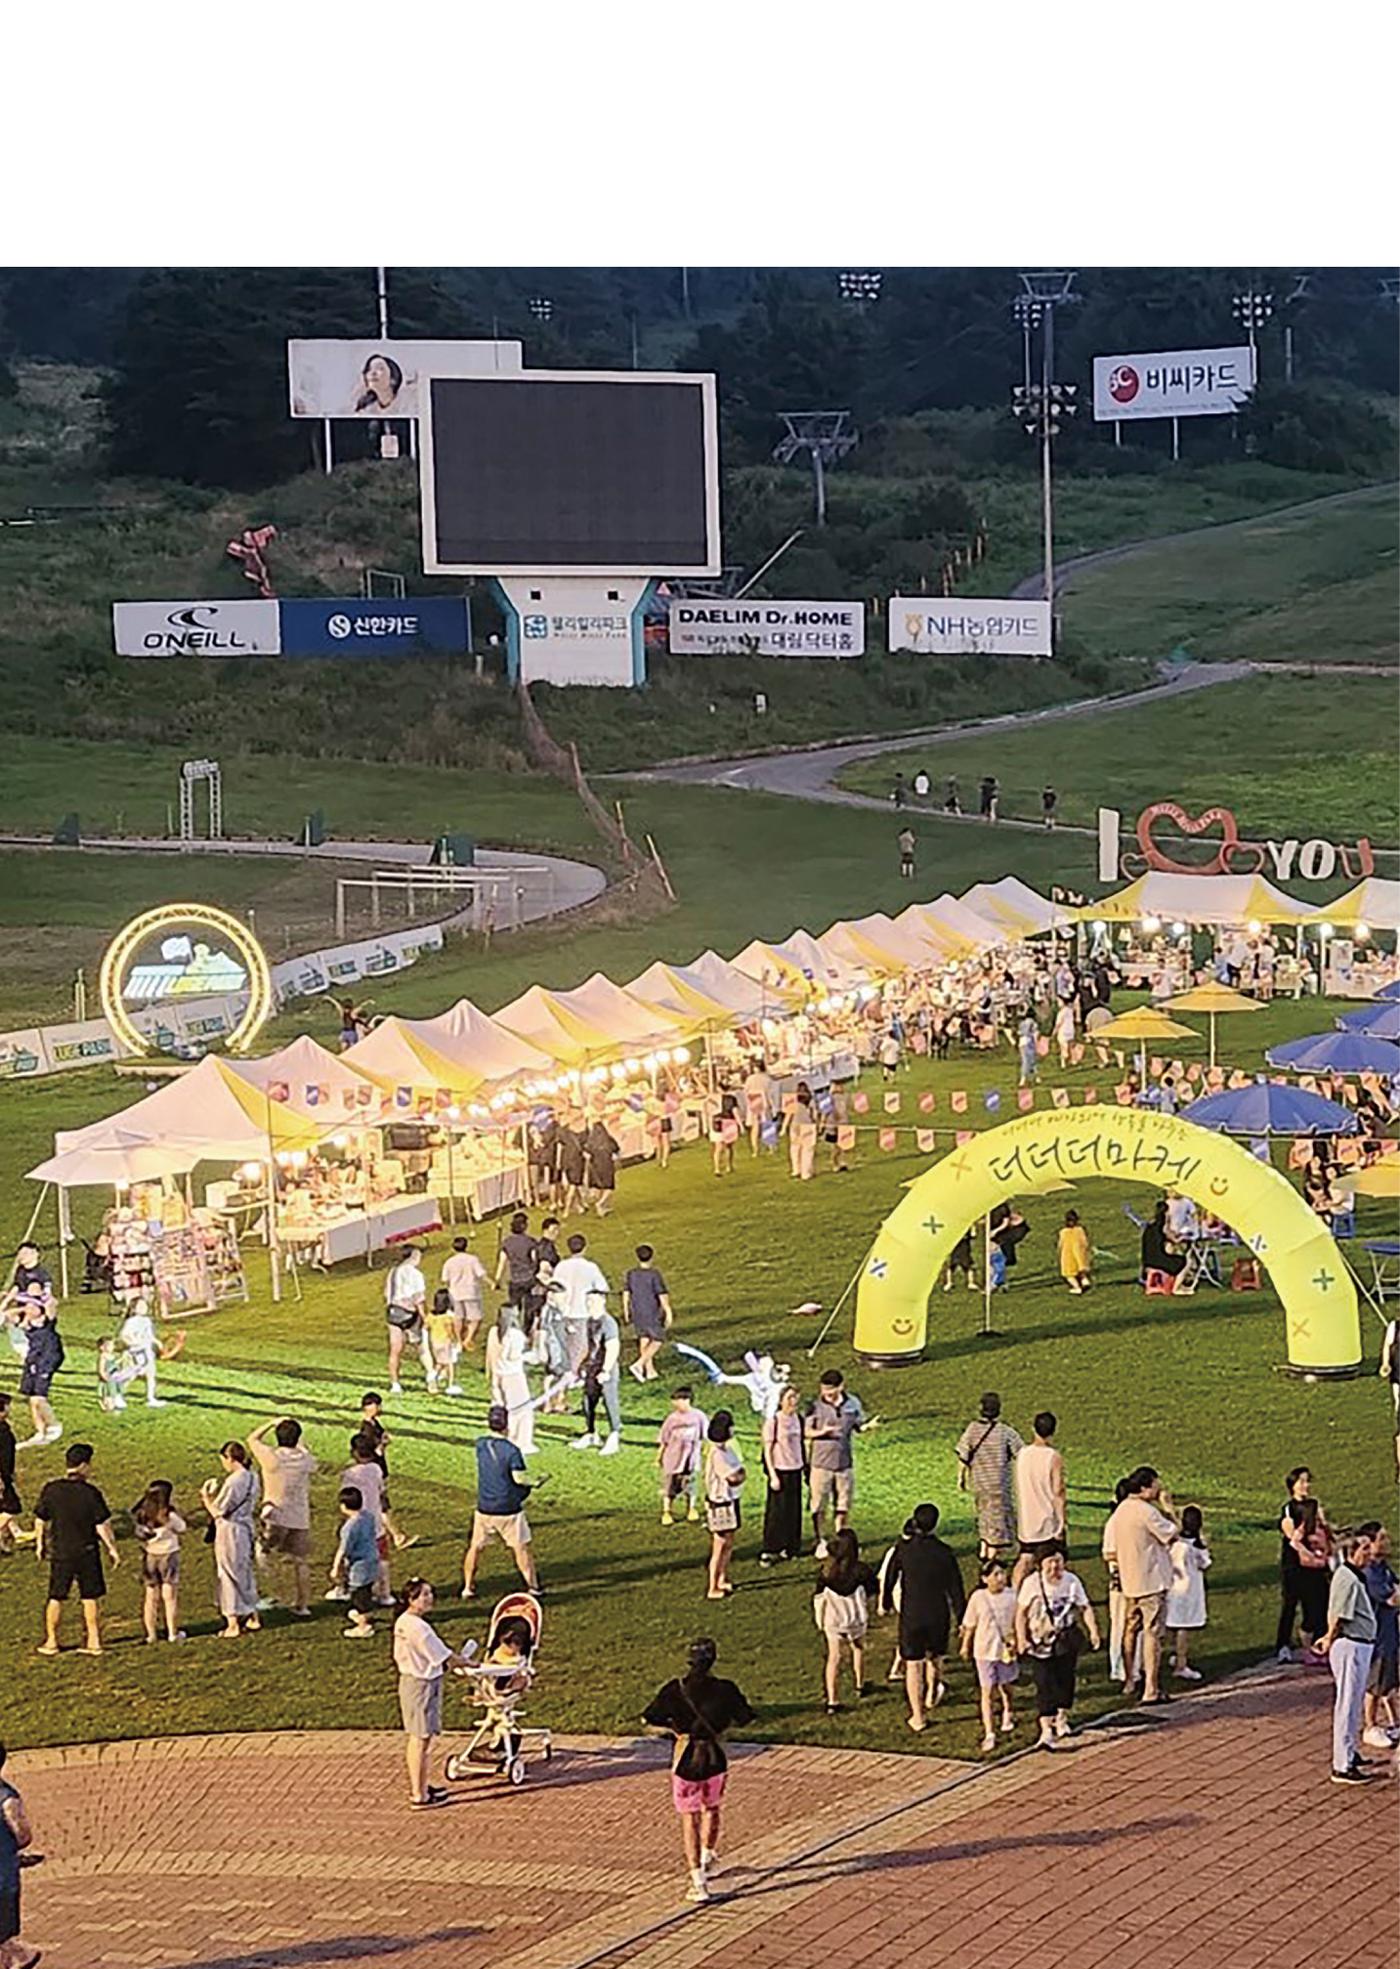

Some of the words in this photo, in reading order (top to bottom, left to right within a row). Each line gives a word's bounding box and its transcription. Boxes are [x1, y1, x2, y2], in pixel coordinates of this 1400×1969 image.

[1147, 364, 1238, 395] 비씨카드
[354, 616, 418, 636] 신한카드
[679, 609, 760, 624] DAELIM
[766, 610, 853, 626] Dr.HOME
[1100, 807, 1120, 882] I
[1265, 837, 1375, 880] YOU
